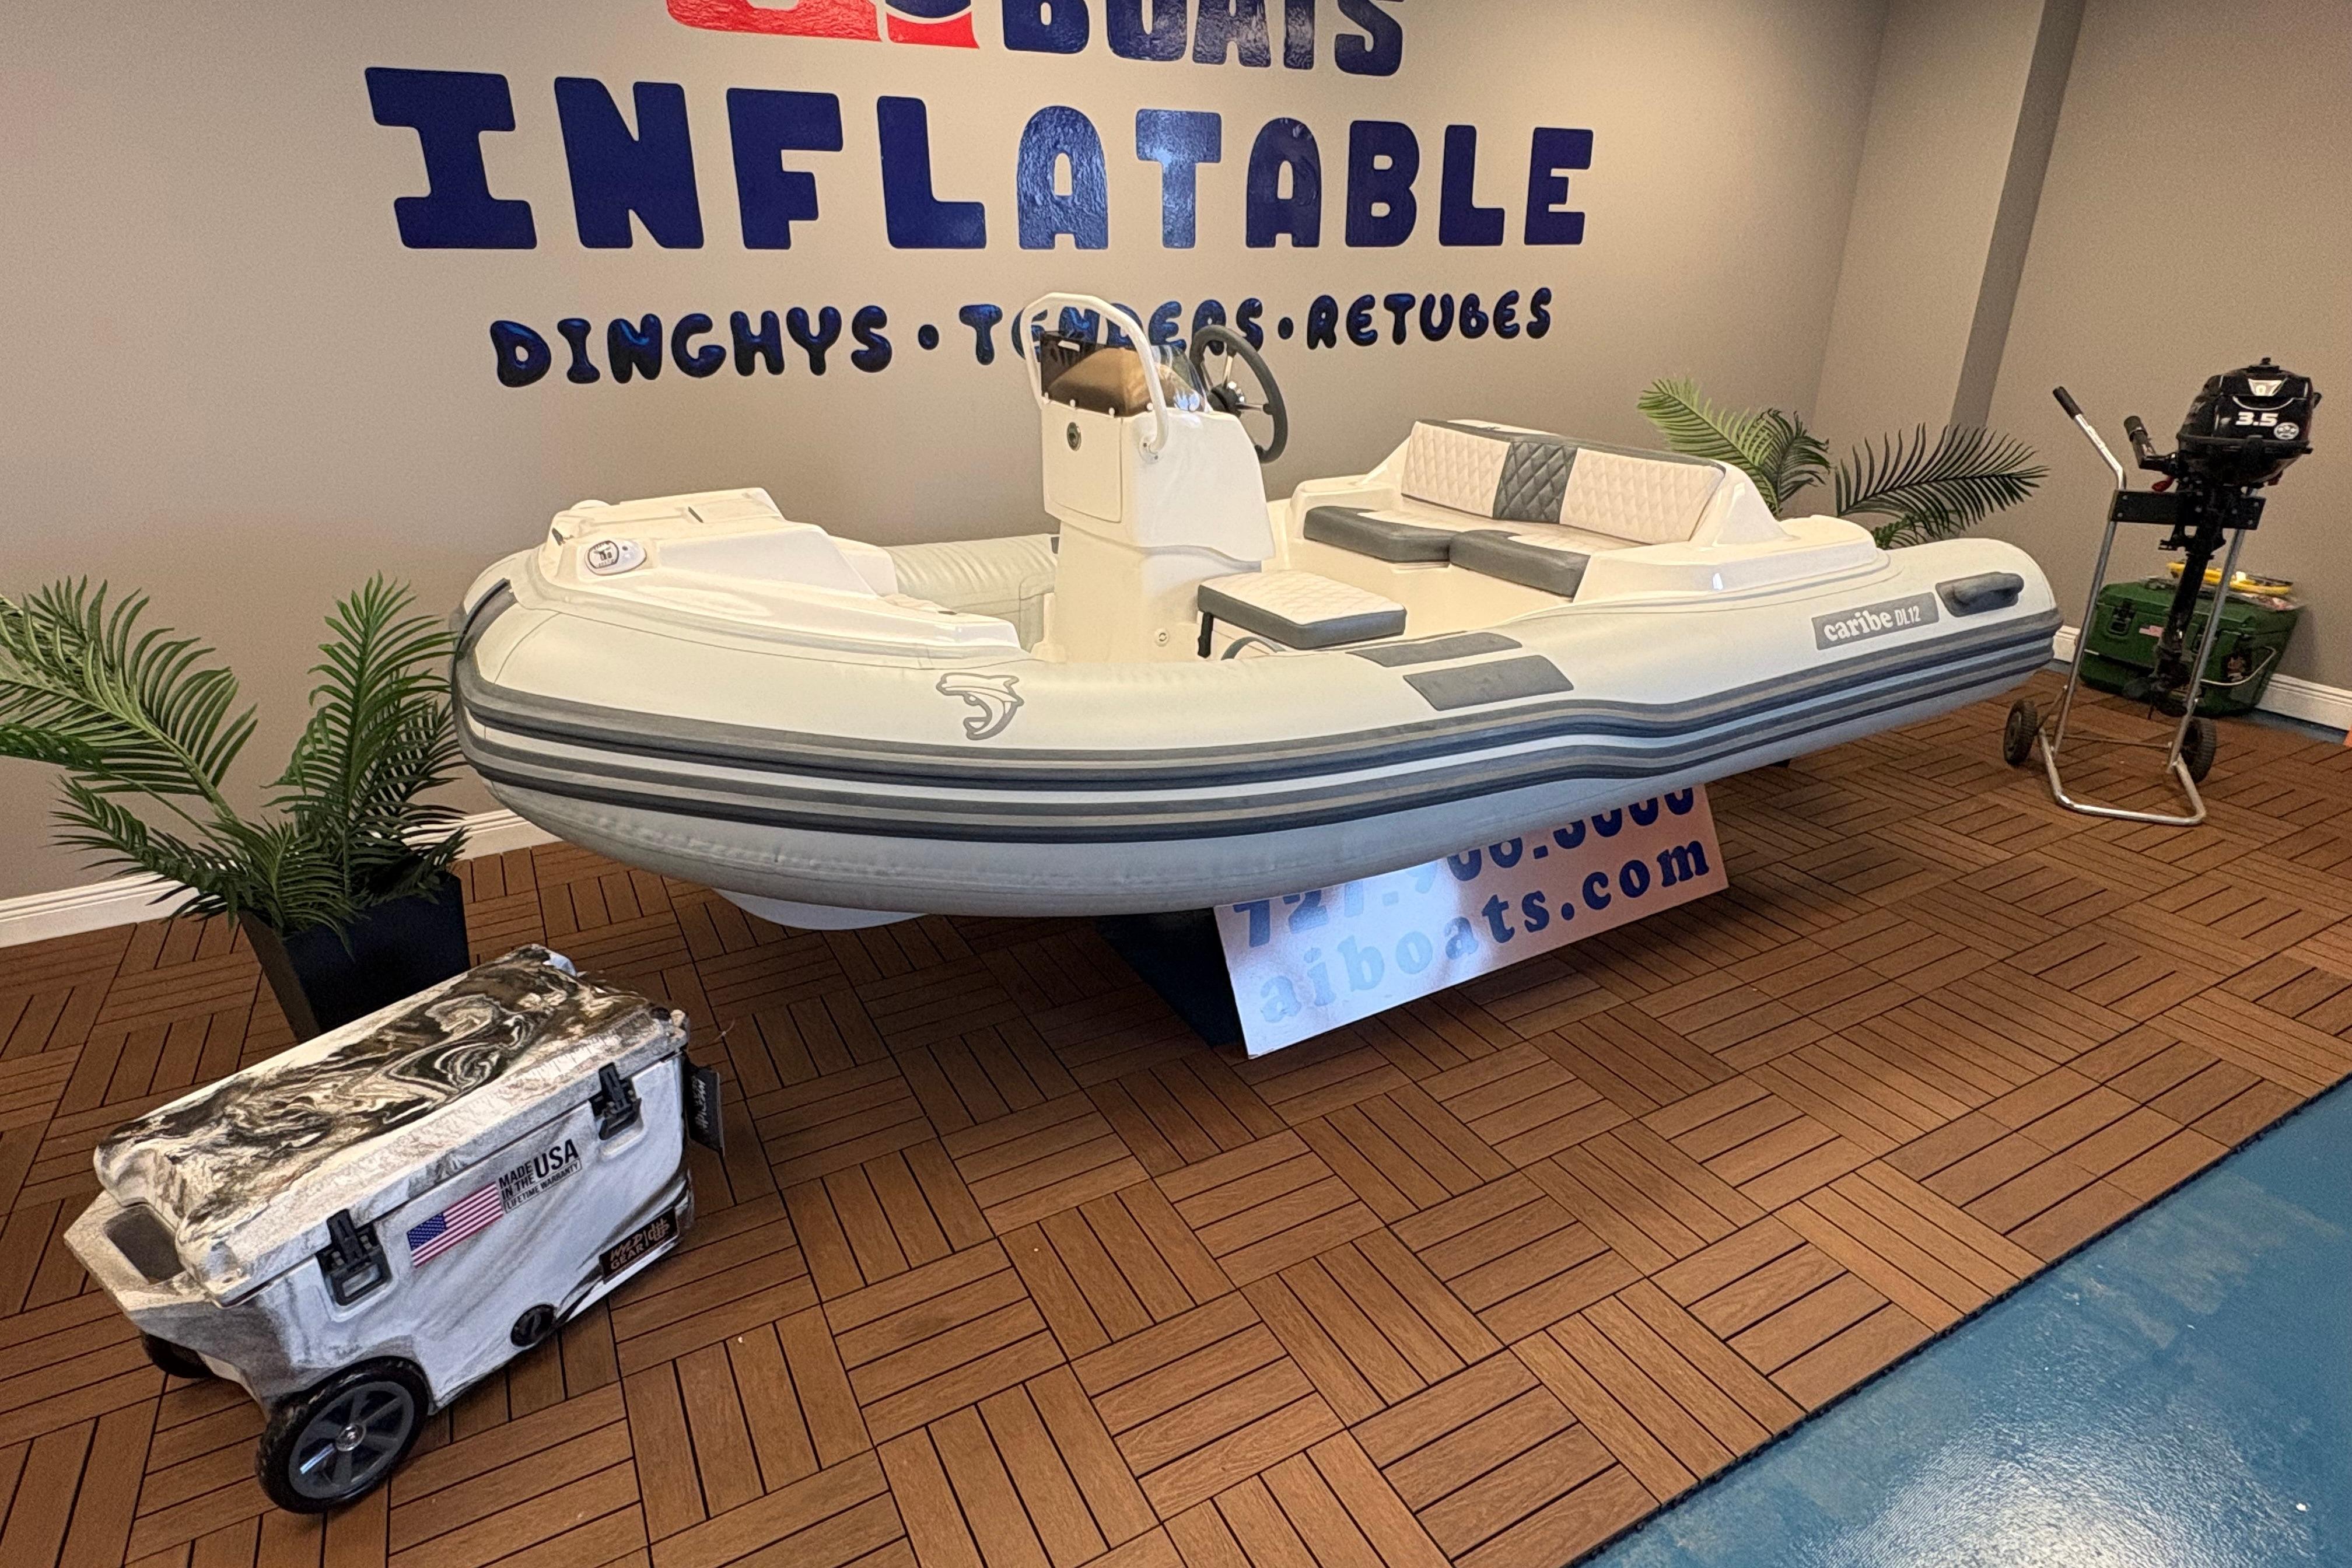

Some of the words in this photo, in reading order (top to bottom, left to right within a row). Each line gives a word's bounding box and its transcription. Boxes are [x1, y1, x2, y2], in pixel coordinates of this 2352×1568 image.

[365, 67, 1594, 250] INFLATABLE
[489, 306, 892, 387] DINGHYS
[1307, 287, 1552, 350] RETUBES
[2235, 411, 2278, 427] 3.5
[1824, 610, 1894, 642] caribe
[1894, 606, 1922, 626] DL12
[1260, 841, 1709, 1023] aiboats.com
[499, 1160, 533, 1189] MADE
[501, 1188, 513, 1200] IN
[514, 1173, 536, 1192] THE
[533, 1139, 579, 1178] USA
[506, 1185, 540, 1210] LIFETIME
[540, 1162, 578, 1189] WARRANTY
[610, 1243, 644, 1269] GEAR
